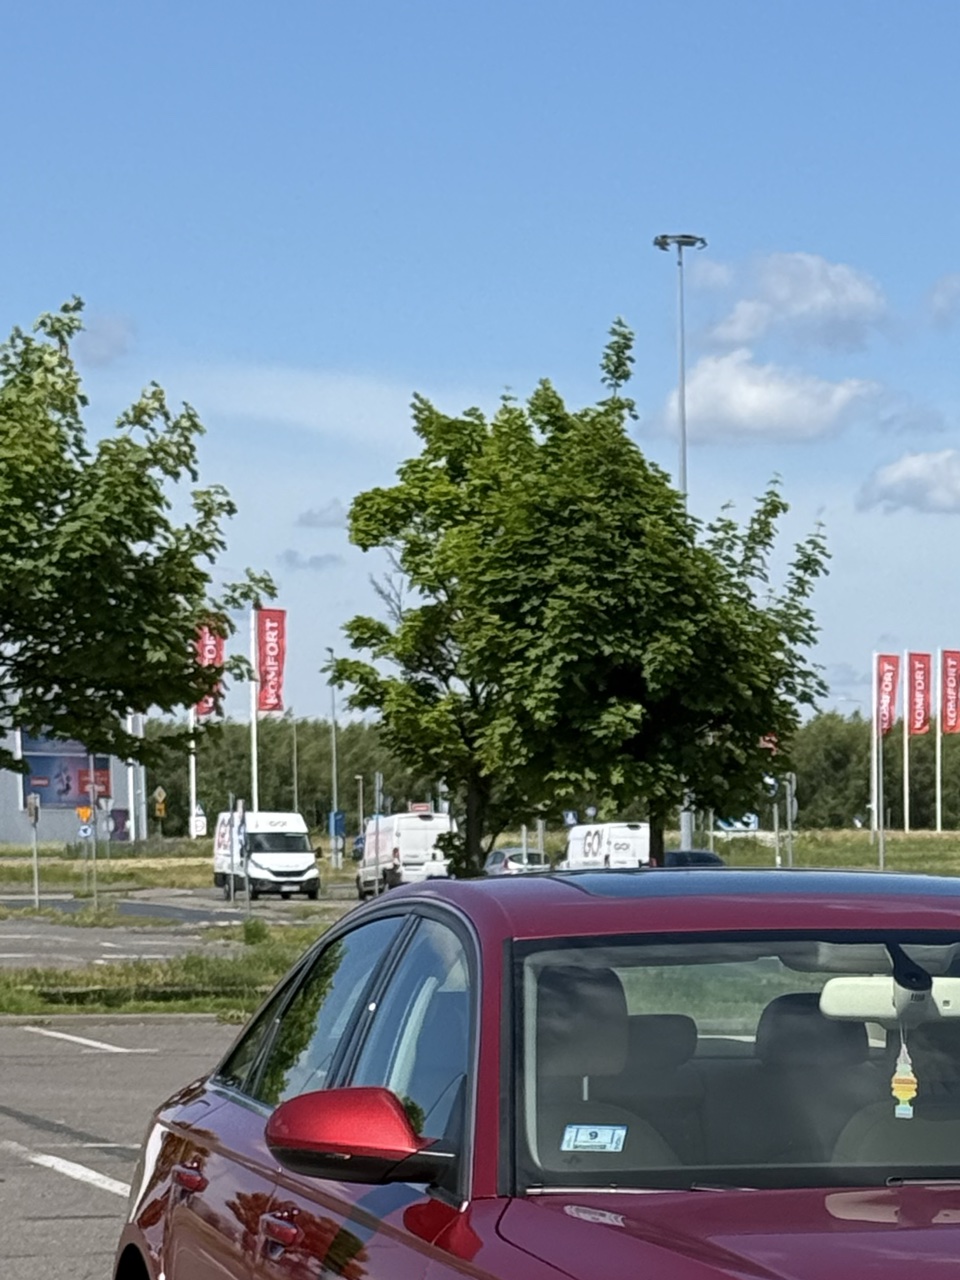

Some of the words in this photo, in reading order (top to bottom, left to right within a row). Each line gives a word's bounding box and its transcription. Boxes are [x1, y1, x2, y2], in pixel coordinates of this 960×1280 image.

[264, 617, 279, 705] KOMFORT
[914, 661, 925, 729] KOMFORT
[946, 658, 958, 726] KOMFORT
[881, 662, 895, 729] KOMFORT
